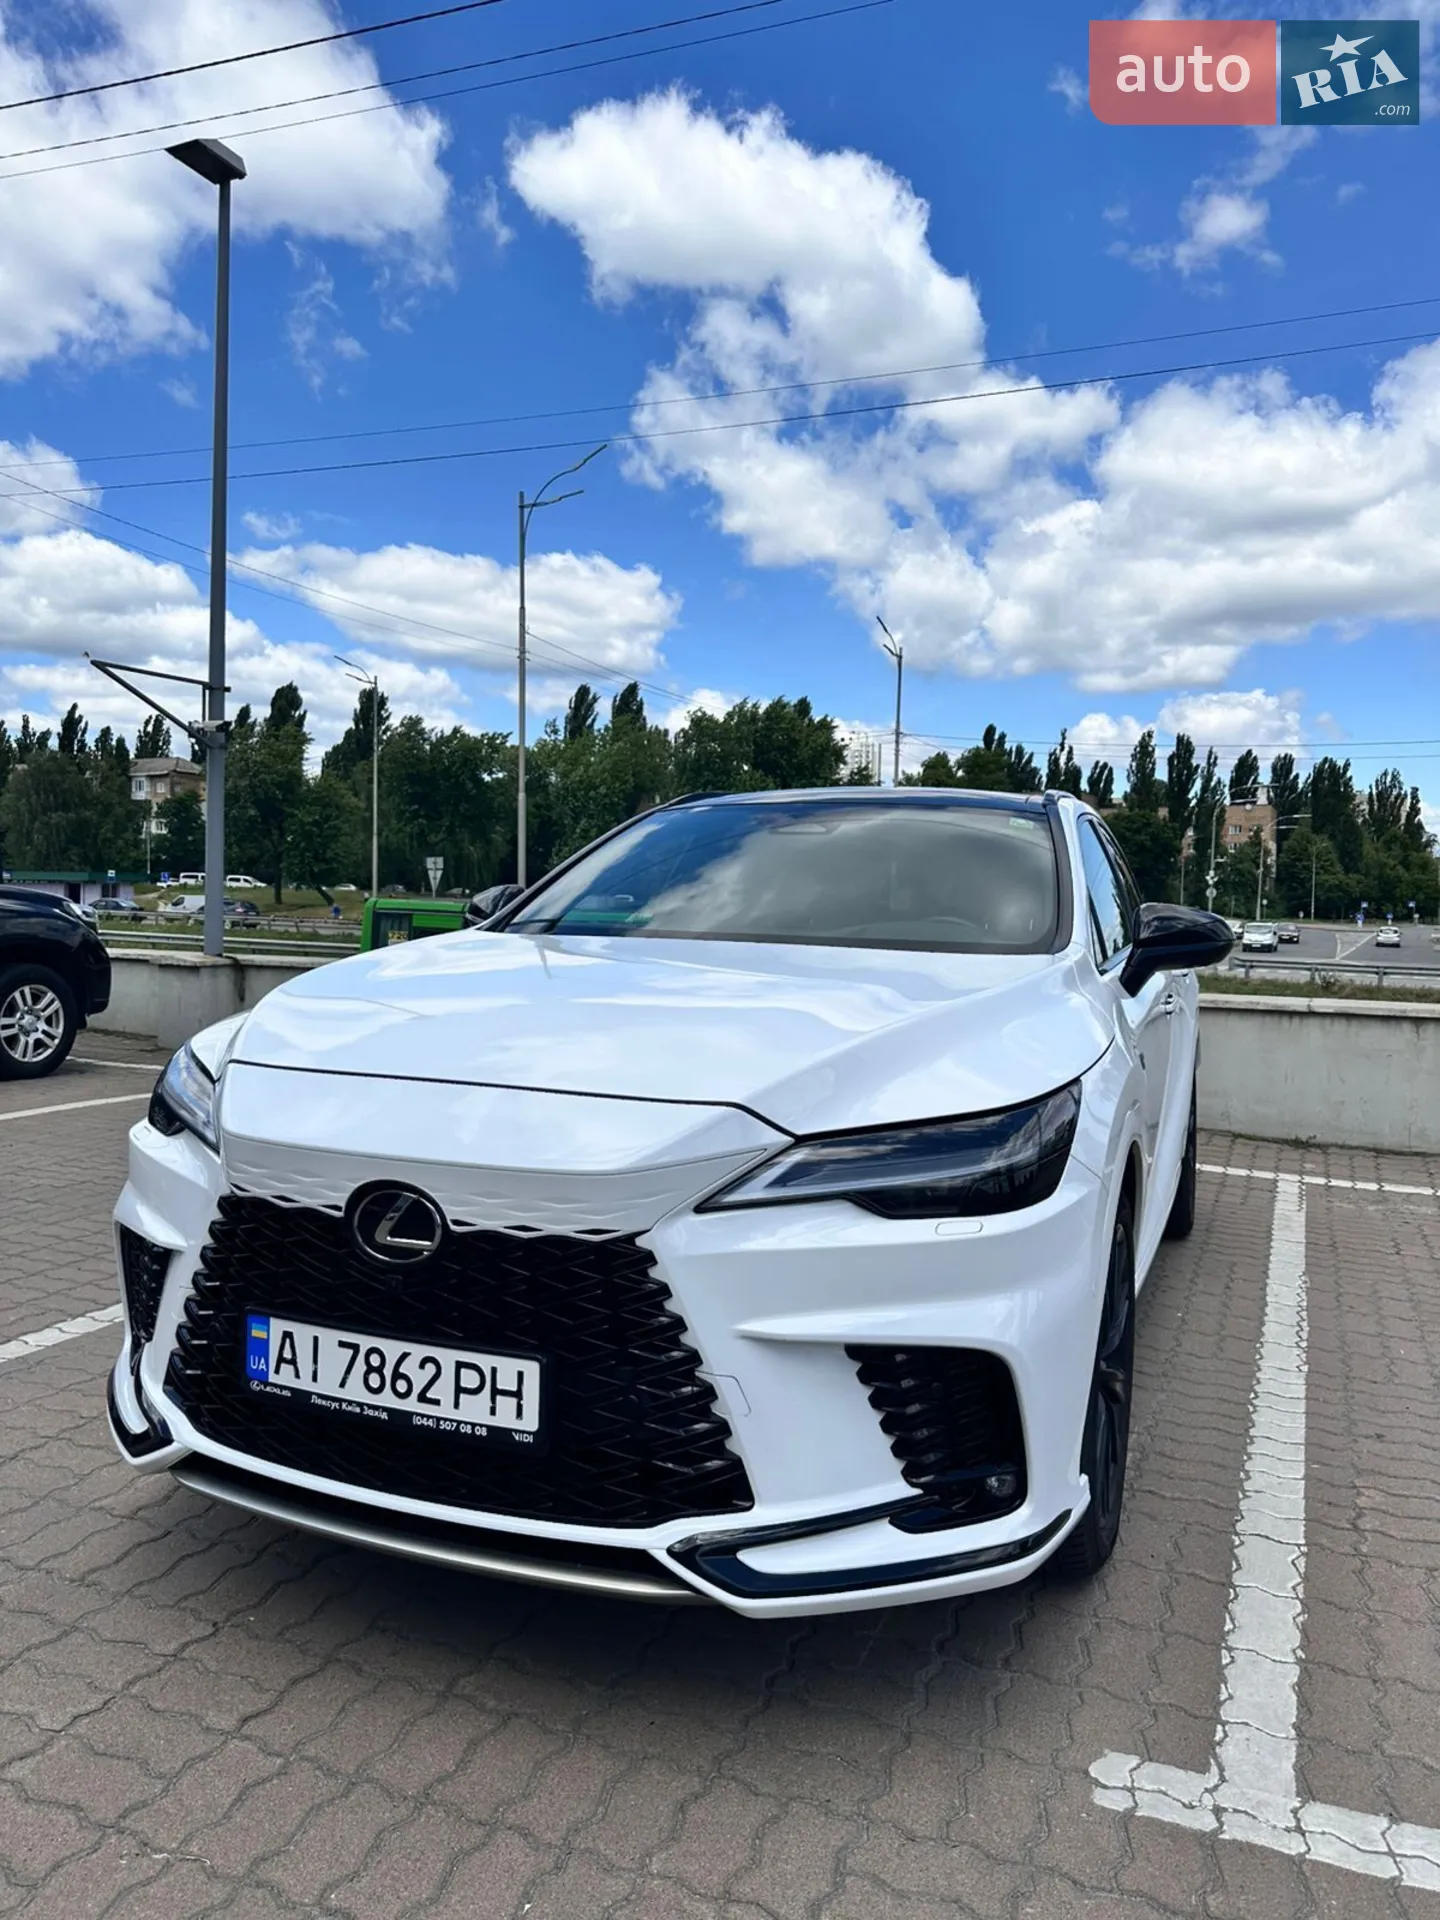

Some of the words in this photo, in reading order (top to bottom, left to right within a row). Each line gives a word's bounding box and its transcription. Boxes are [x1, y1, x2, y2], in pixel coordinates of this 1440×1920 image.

[249, 1354, 268, 1373] UA
[363, 1405, 389, 1420] Захід
[412, 1414, 437, 1429] (044)
[439, 1420, 457, 1431] 507
[459, 1423, 472, 1434] 08
[474, 1426, 488, 1436] 08
[512, 1431, 534, 1443] VIDI
